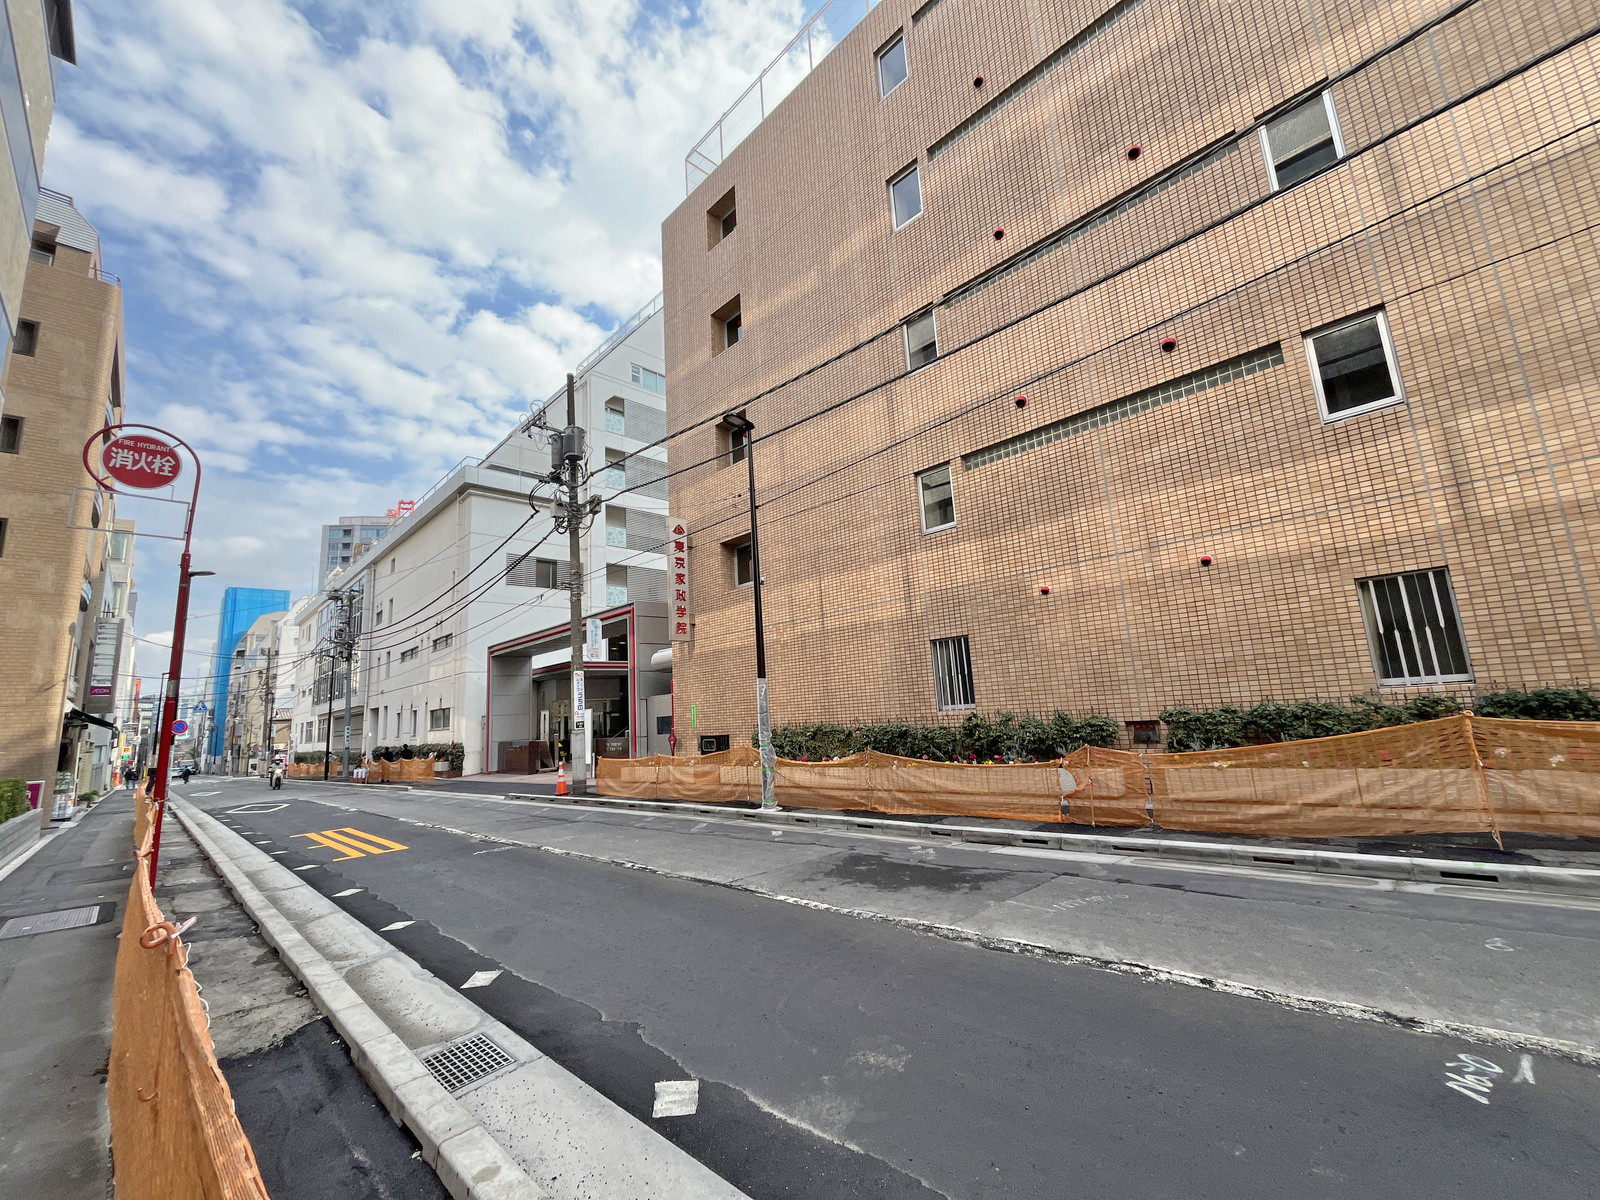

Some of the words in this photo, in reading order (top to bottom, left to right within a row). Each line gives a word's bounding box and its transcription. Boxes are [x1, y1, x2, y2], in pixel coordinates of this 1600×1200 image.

[108, 446, 176, 476] 消火栓
[118, 439, 135, 447] FIRE
[137, 441, 171, 453] HYDRANT
[673, 540, 687, 635] 東京家政学院
